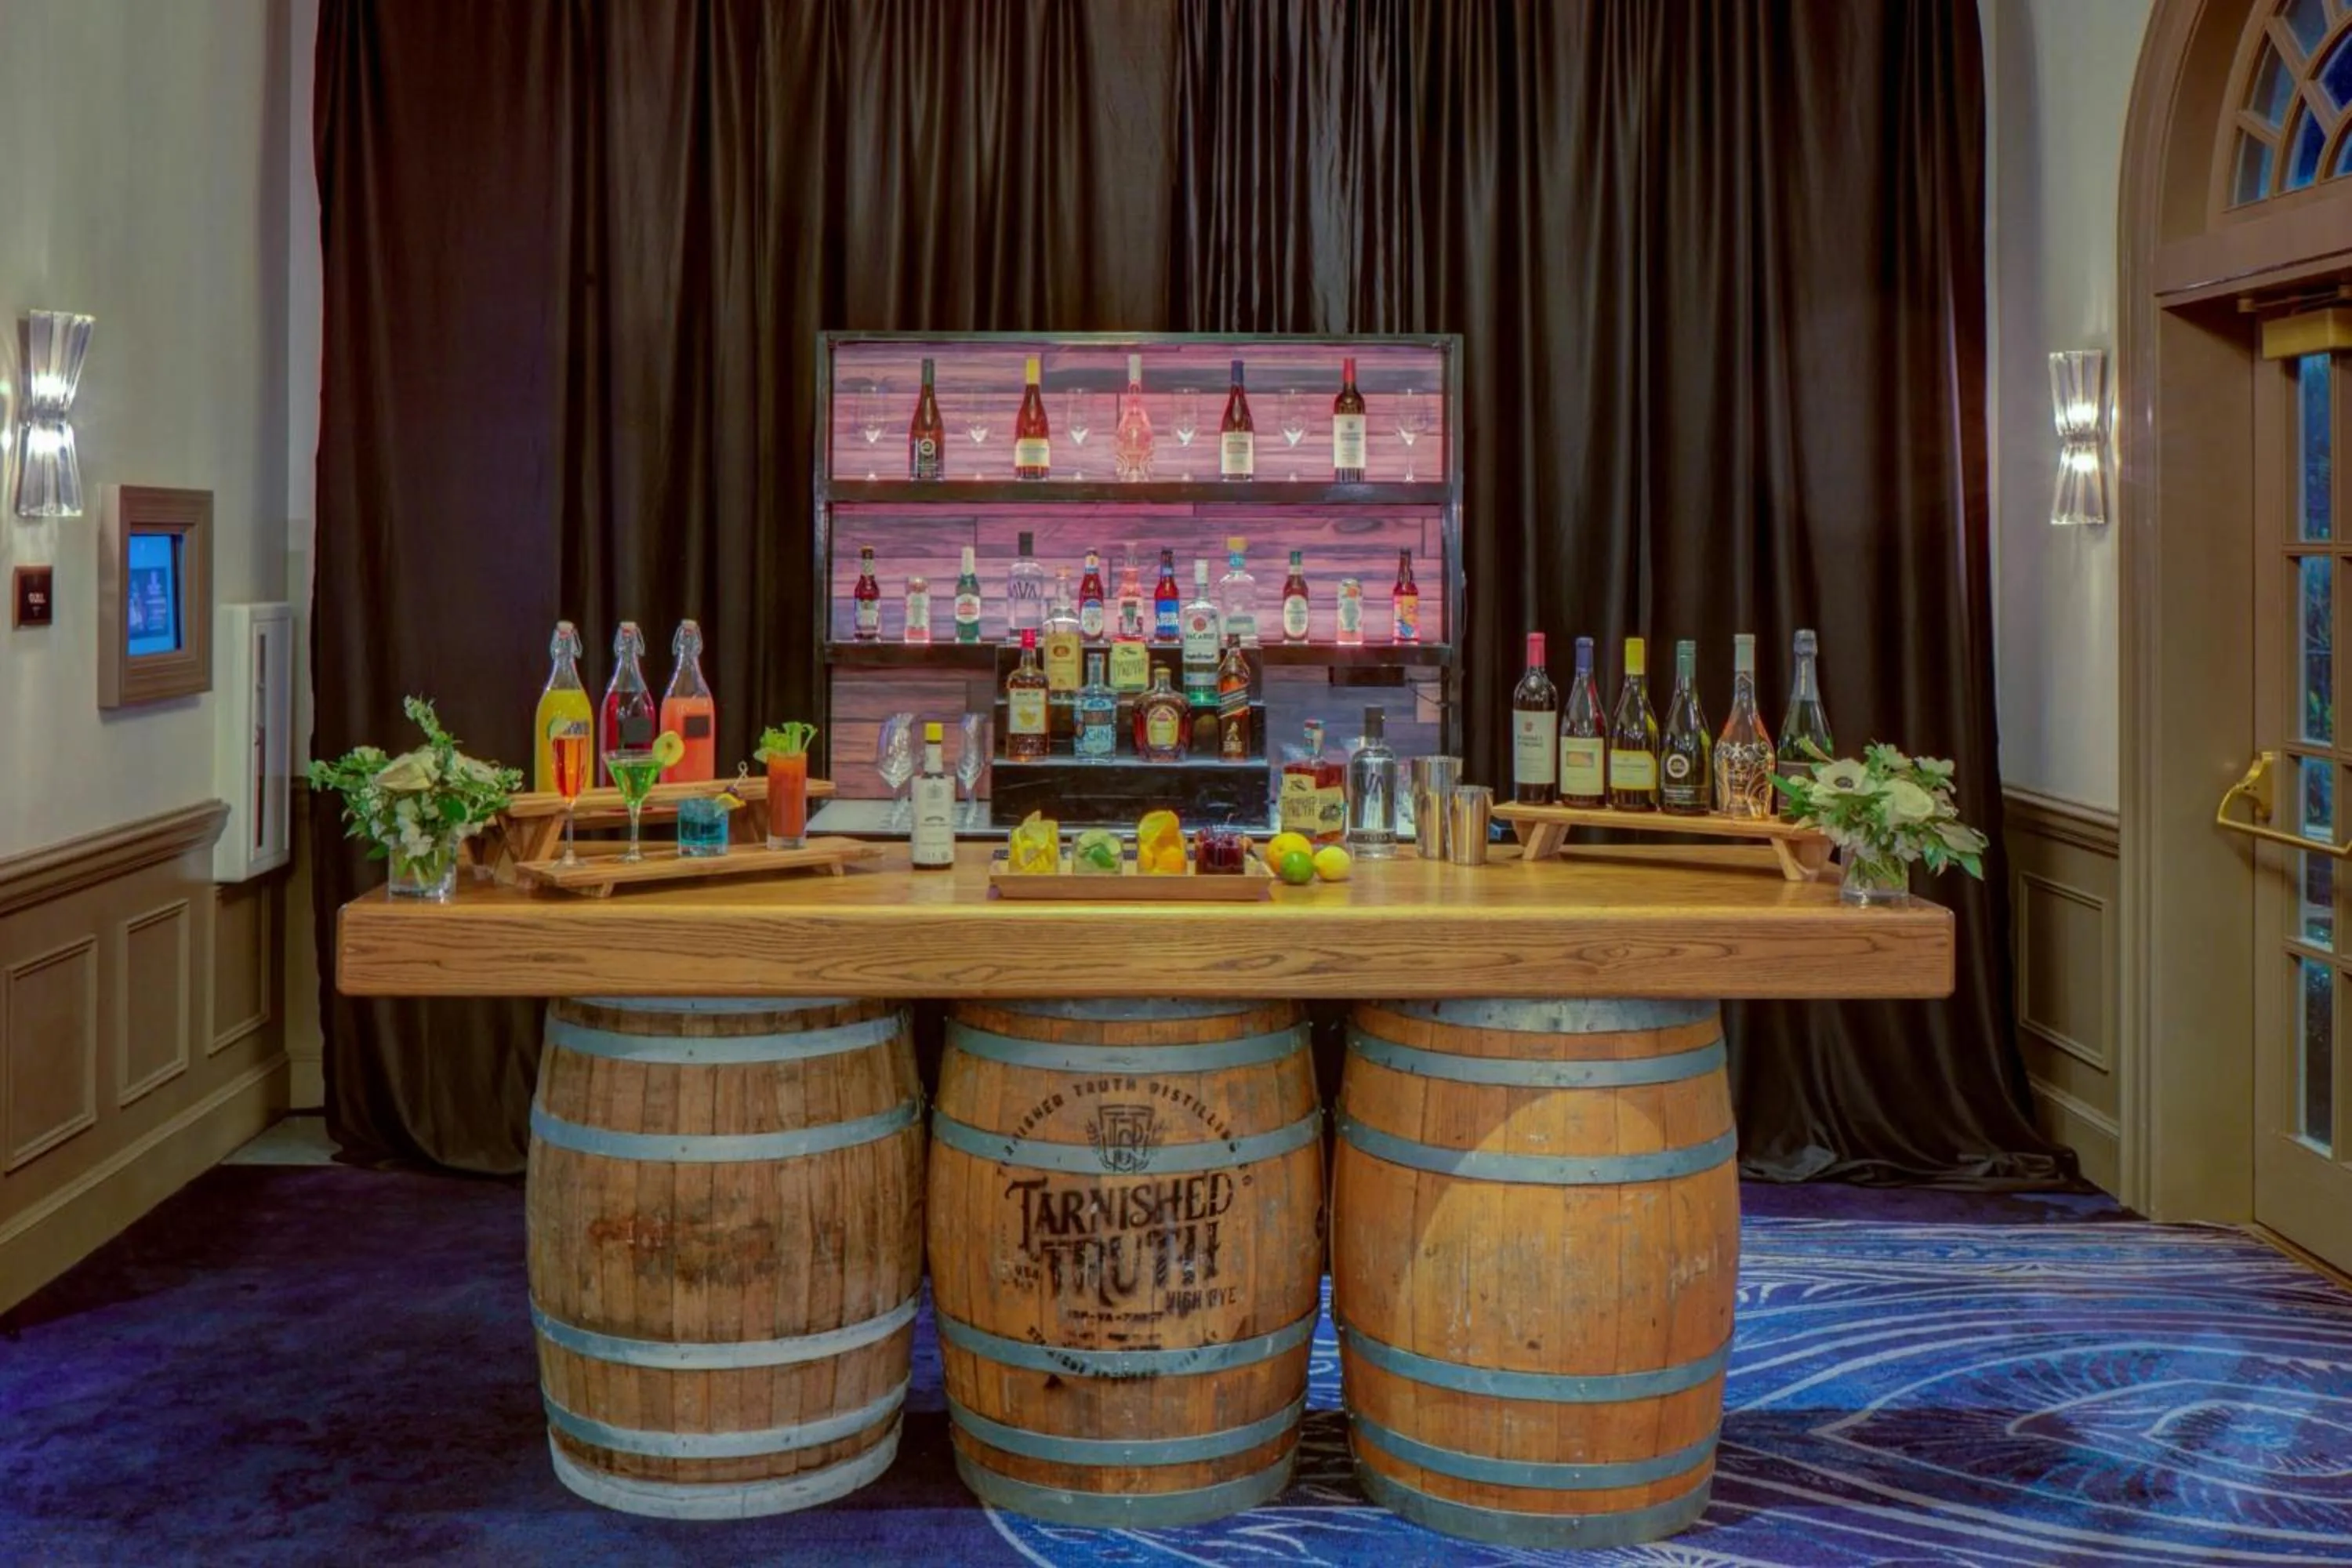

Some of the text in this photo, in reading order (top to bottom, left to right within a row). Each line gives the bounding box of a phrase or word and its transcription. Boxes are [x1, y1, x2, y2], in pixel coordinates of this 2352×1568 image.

[1072, 1077, 1137, 1098] TRUTH
[1005, 1172, 1233, 1254] TARNISHED
[1039, 1221, 1221, 1307] TRUTH
